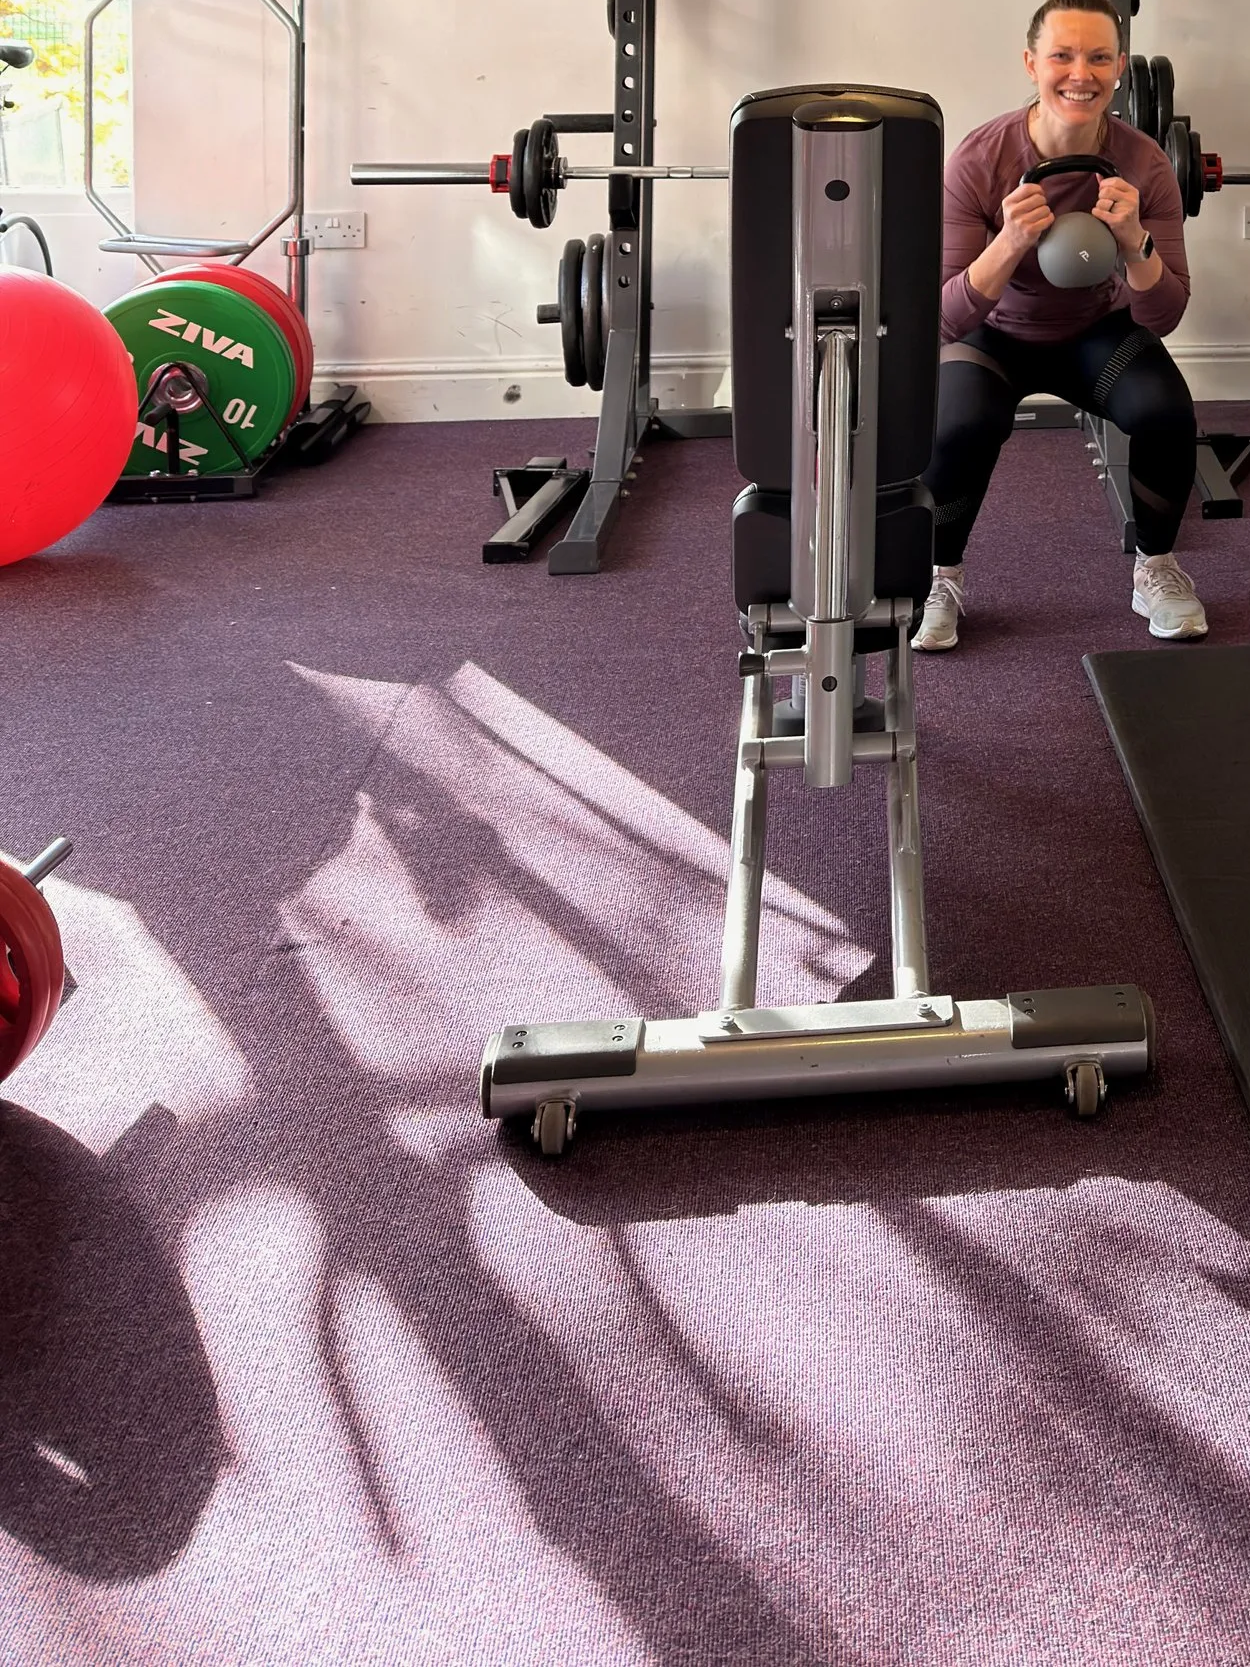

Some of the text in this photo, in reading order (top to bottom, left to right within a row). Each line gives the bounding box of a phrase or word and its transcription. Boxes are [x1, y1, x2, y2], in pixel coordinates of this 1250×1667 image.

[148, 308, 254, 369] ZIVA
[222, 398, 258, 430] 10
[134, 421, 209, 466] ZIV
